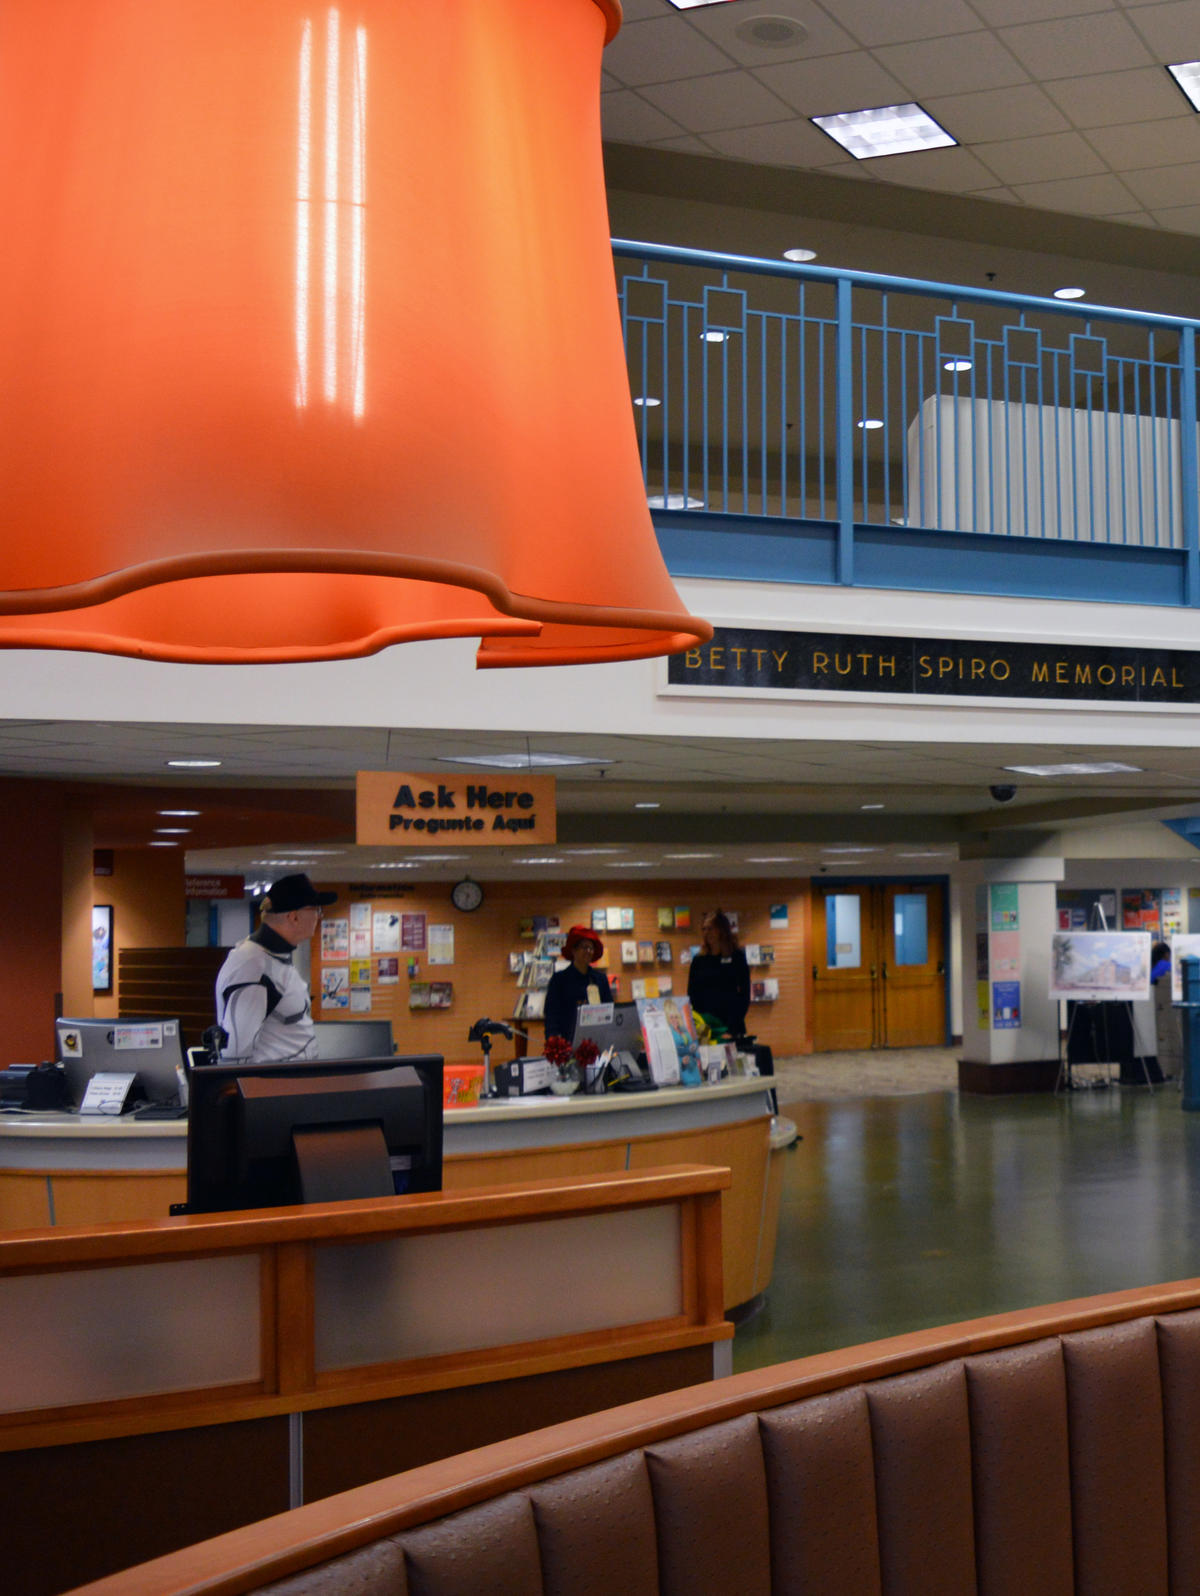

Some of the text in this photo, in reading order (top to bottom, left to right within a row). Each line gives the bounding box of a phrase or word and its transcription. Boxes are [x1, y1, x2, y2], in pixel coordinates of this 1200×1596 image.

[684, 646, 789, 673] BETTY
[812, 651, 897, 677] RUTH
[918, 655, 1010, 681] SPIRO
[1031, 661, 1184, 688] MEMORIAL
[393, 784, 535, 810] Ask Here
[389, 813, 537, 834] Pregunte Aquí
